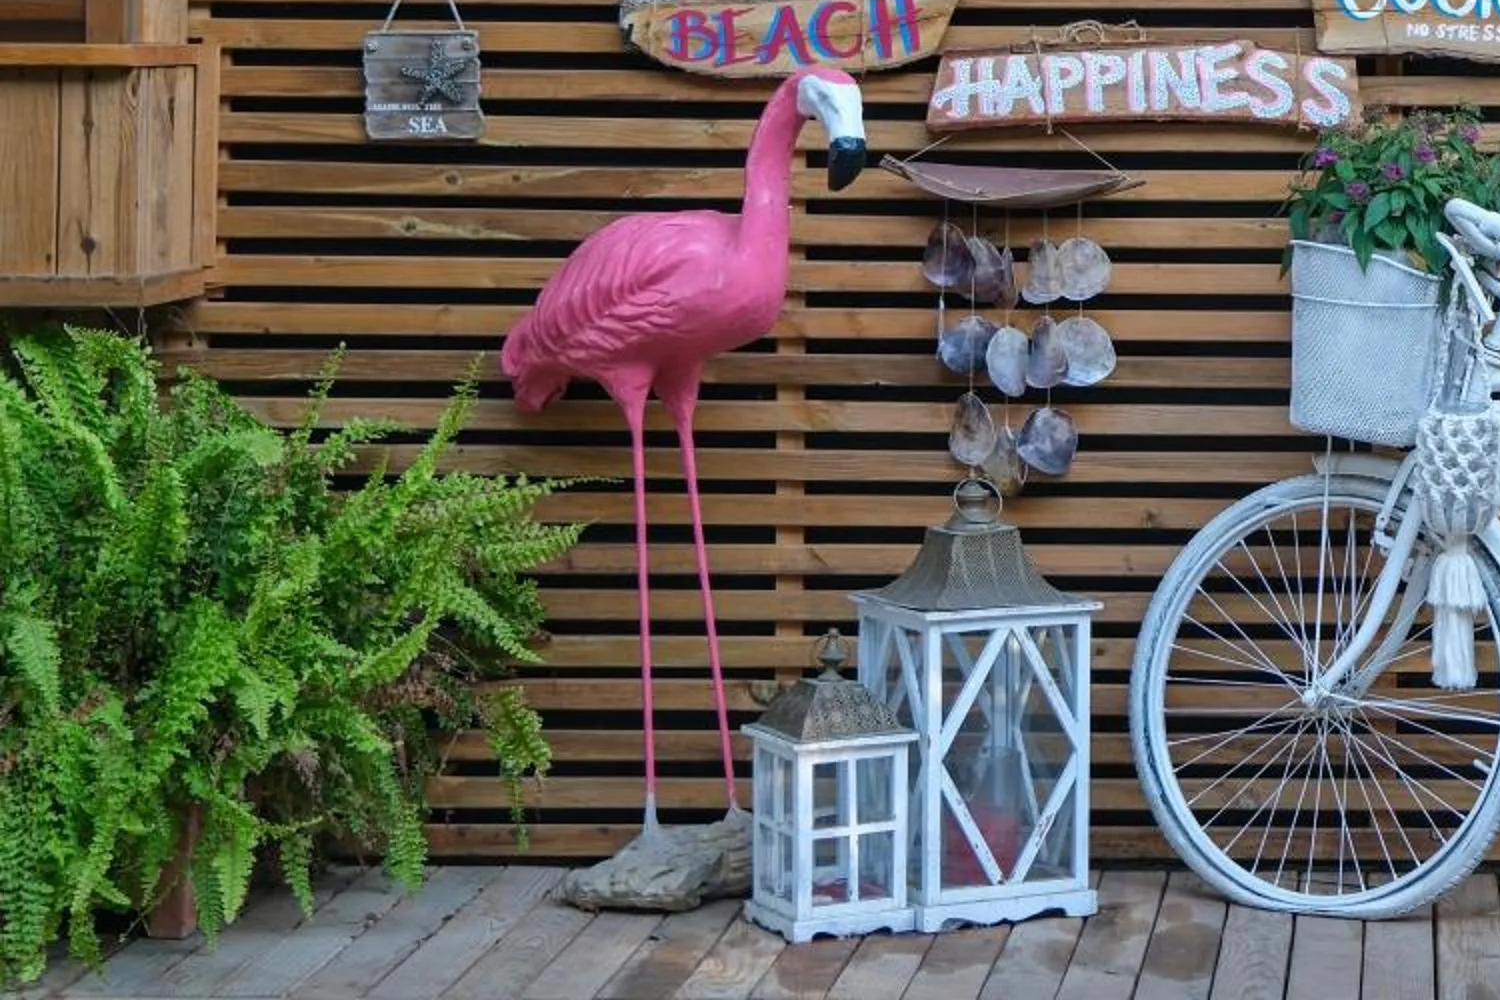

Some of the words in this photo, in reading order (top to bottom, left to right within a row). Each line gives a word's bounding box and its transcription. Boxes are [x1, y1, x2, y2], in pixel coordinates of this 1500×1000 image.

[1406, 22, 1429, 39] NO
[928, 40, 1354, 128] HAPPINESS
[408, 116, 448, 134] SEA
